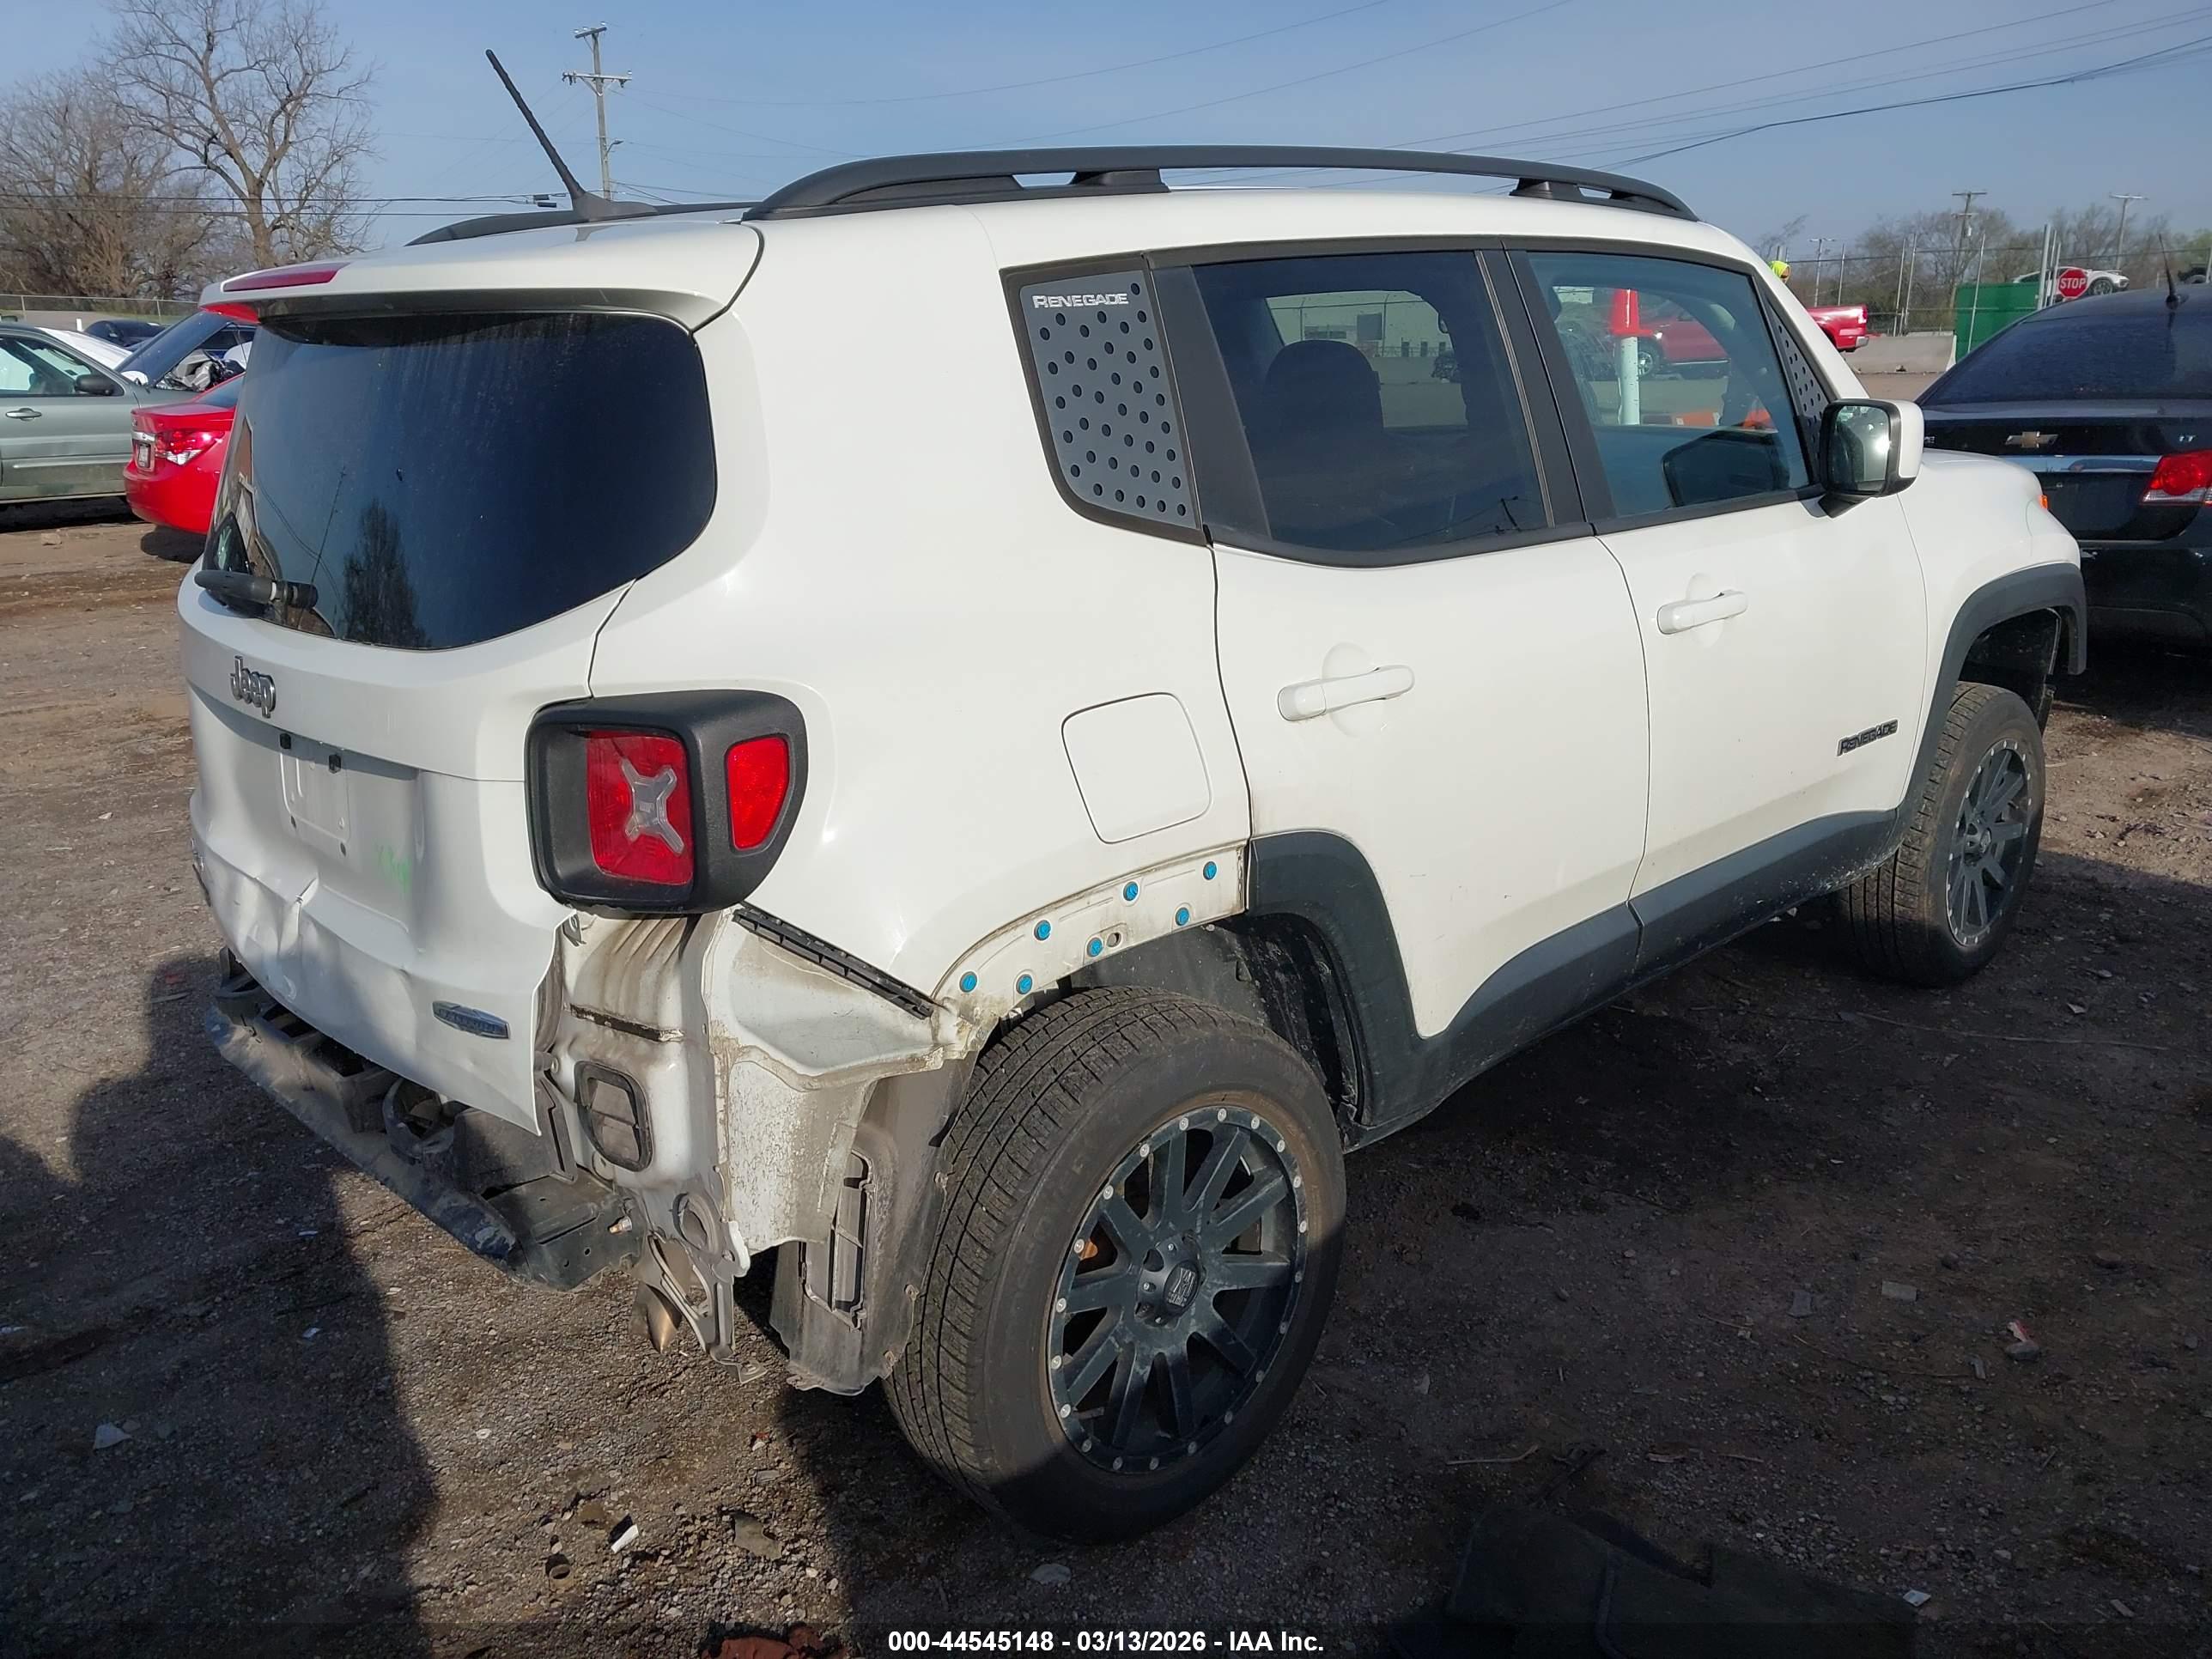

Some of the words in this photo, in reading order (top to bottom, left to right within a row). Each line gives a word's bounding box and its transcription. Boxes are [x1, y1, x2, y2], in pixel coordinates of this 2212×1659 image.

[2060, 277, 2087, 289] STOP
[1031, 293, 1129, 308] RENEGADE
[230, 655, 276, 719] Jeep
[1837, 719, 1899, 757] RENEGADE
